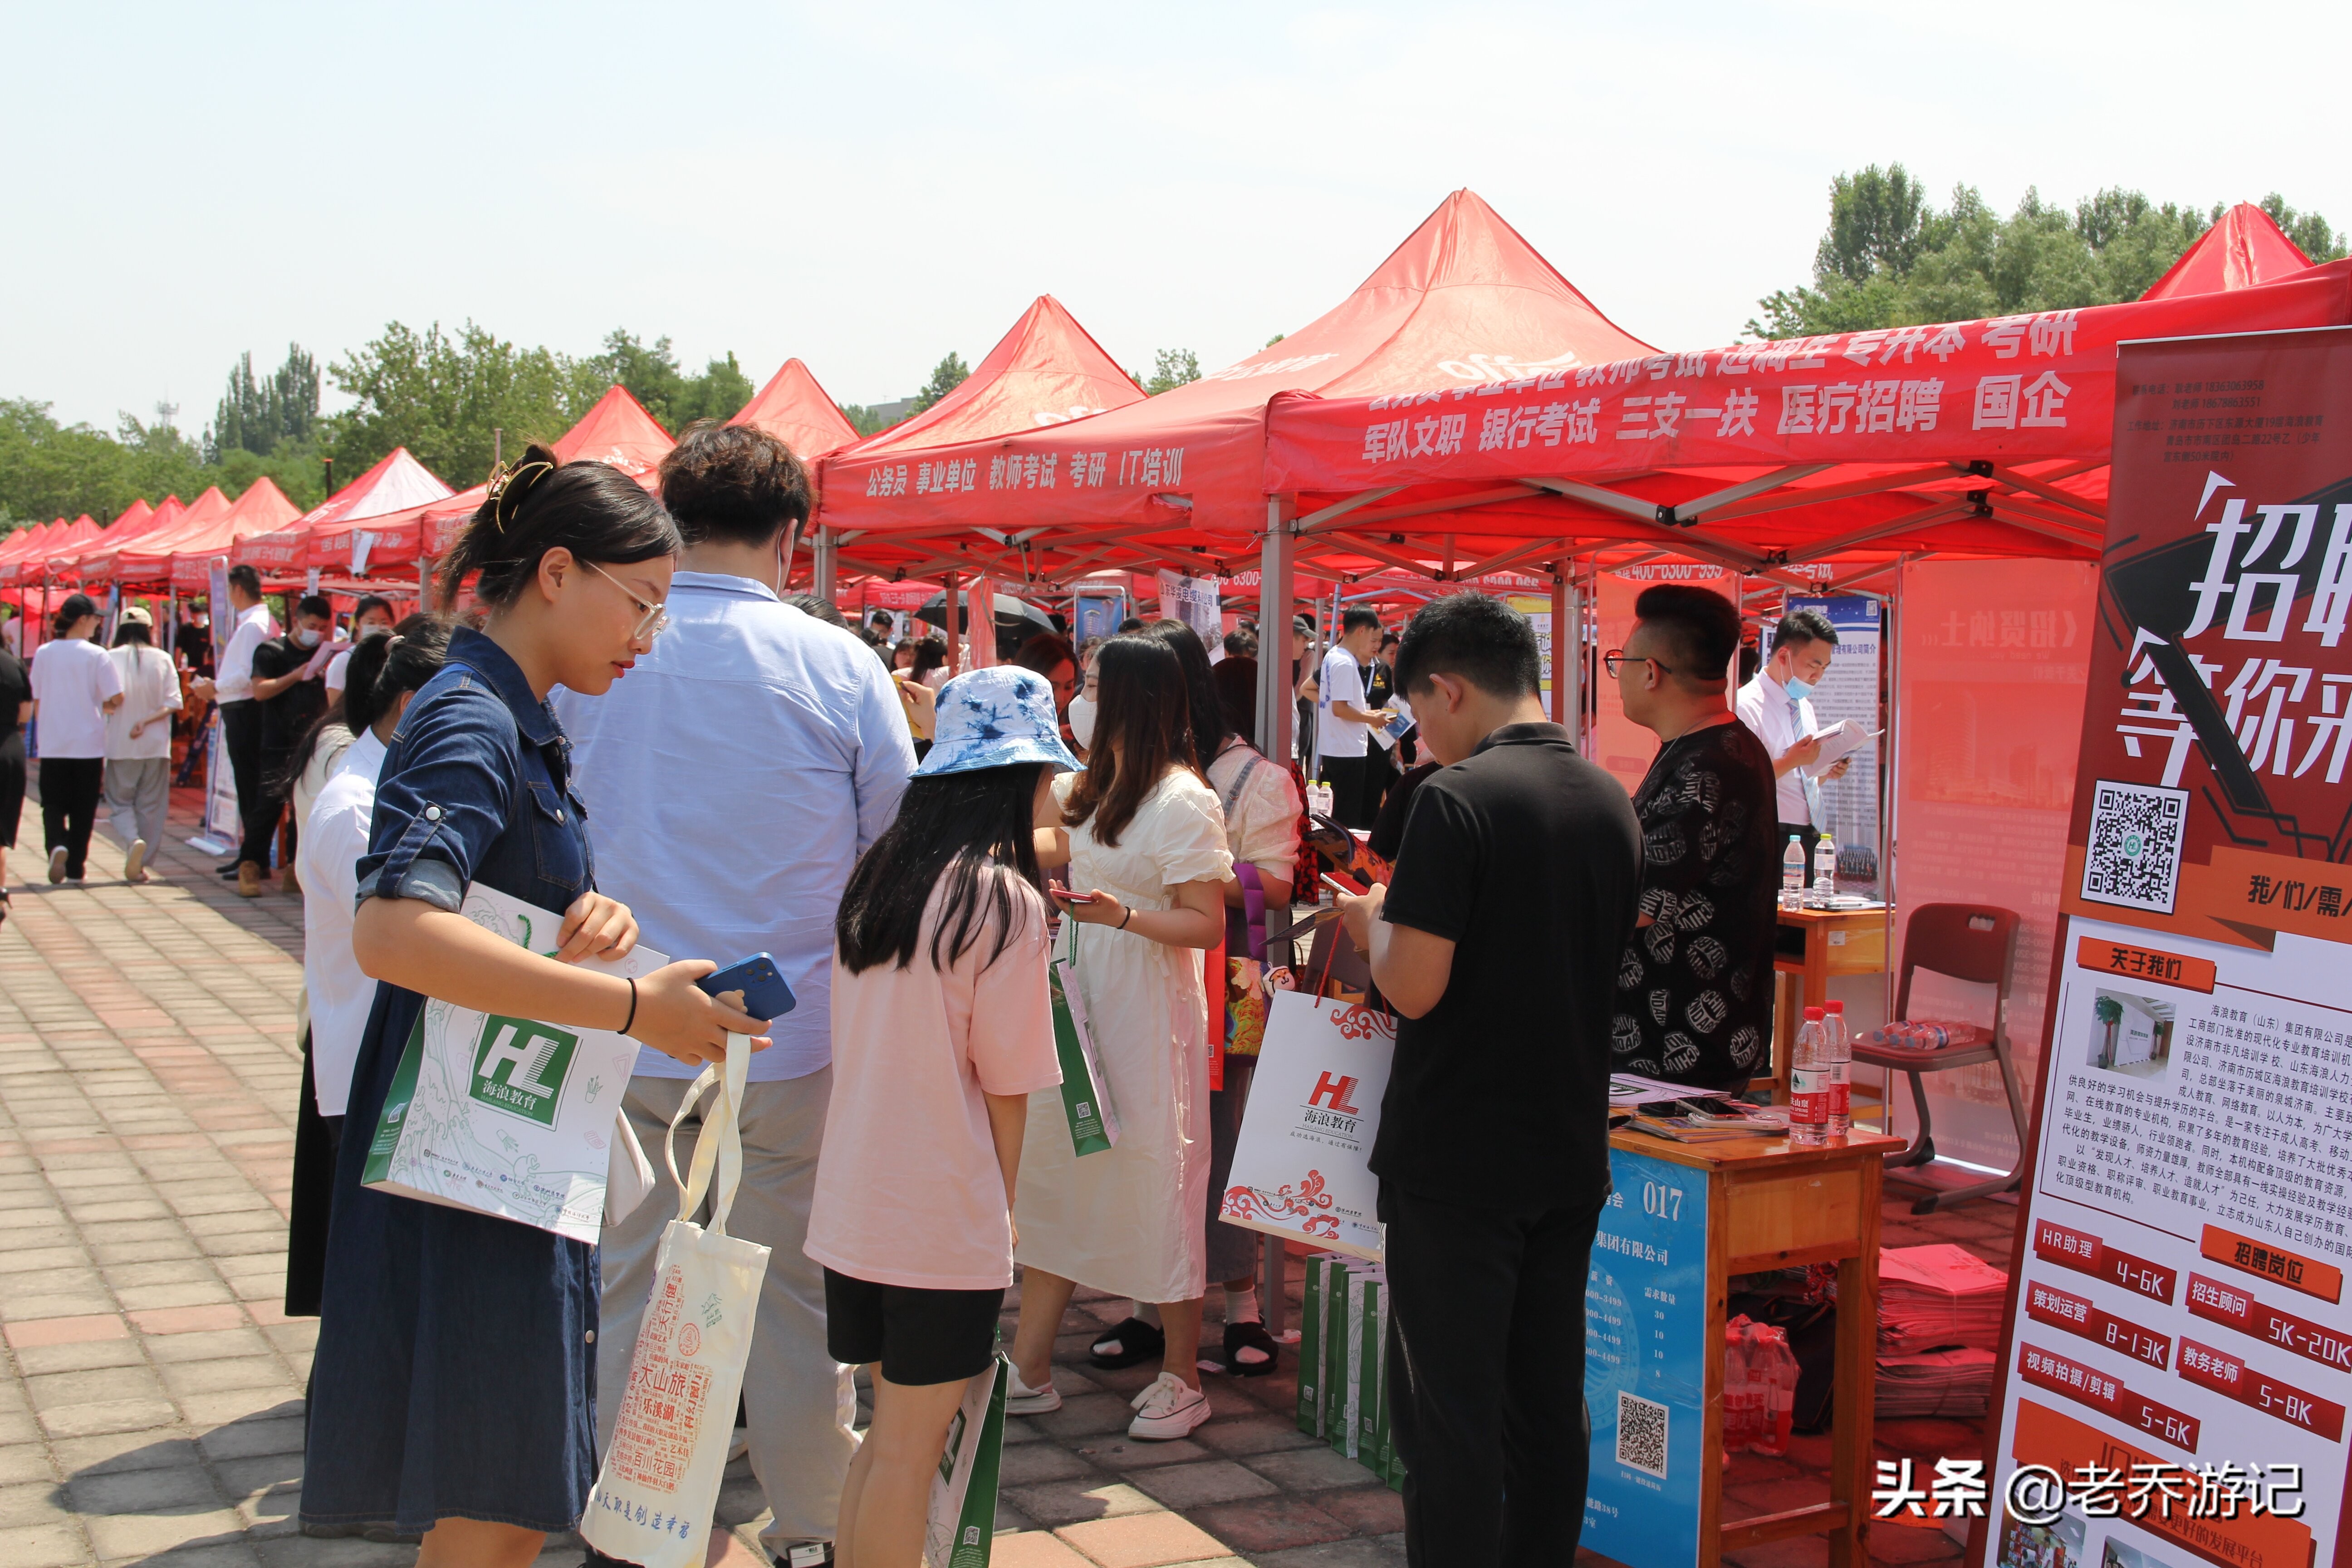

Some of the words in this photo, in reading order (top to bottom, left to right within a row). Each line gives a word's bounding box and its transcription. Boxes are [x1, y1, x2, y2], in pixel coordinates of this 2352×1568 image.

[1982, 309, 2078, 358] 考研
[1362, 414, 1466, 463] 军队文职
[1478, 399, 1600, 452] 银行考试
[1616, 387, 1759, 440] 三支一扶
[1777, 377, 1945, 435] 医疗招聘
[1972, 371, 2072, 430] 国企
[867, 465, 908, 497] 公务员
[916, 458, 976, 494] 事业单位
[989, 453, 1057, 490] 教师考试
[1070, 451, 1107, 488] 考研
[1119, 447, 1185, 486] IT培训
[2110, 947, 2181, 981] 关于我们
[2185, 1034, 2352, 1086] 设济南市非凡培训学校、山东海浪人力
[2188, 1018, 2352, 1067] 工商部门批准的现代化专业教育培训机
[478, 1024, 560, 1099] HL
[483, 1080, 537, 1111] 海浪教育
[505, 1102, 534, 1117] EDUCATION
[1308, 1071, 1359, 1115] HL
[1303, 1123, 1324, 1132] HAILANG
[1325, 1129, 1353, 1139] EDUCATION
[1304, 1109, 1357, 1133] 海浪教育
[1643, 1181, 1683, 1221] 017
[1596, 1230, 1668, 1266] 集团有限公司
[2042, 1229, 2092, 1259] HR助理
[2234, 1241, 2304, 1284] 招聘岗位
[1644, 1287, 1676, 1305] 需求数量
[2116, 1260, 2164, 1297] 4-6K
[658, 1283, 677, 1332] 天行健
[1654, 1310, 1665, 1320] 30
[2033, 1289, 2087, 1323] 策划运营
[2192, 1281, 2247, 1318] 招生顾问
[1655, 1330, 1664, 1340] 10
[2106, 1323, 2166, 1365] 8-13K
[2269, 1317, 2352, 1367] 5K-20K
[1654, 1349, 1664, 1359] 10
[2183, 1346, 2239, 1383] 教务老师
[638, 1362, 686, 1398] 大山旅
[1655, 1369, 1661, 1378] 8
[2027, 1351, 2116, 1402] 视频拍摄/剪辑
[642, 1398, 675, 1423] 乐溪湖
[2259, 1385, 2313, 1425] 5-8K
[2141, 1406, 2191, 1446] 5-6K
[634, 1451, 676, 1478] 百川花园
